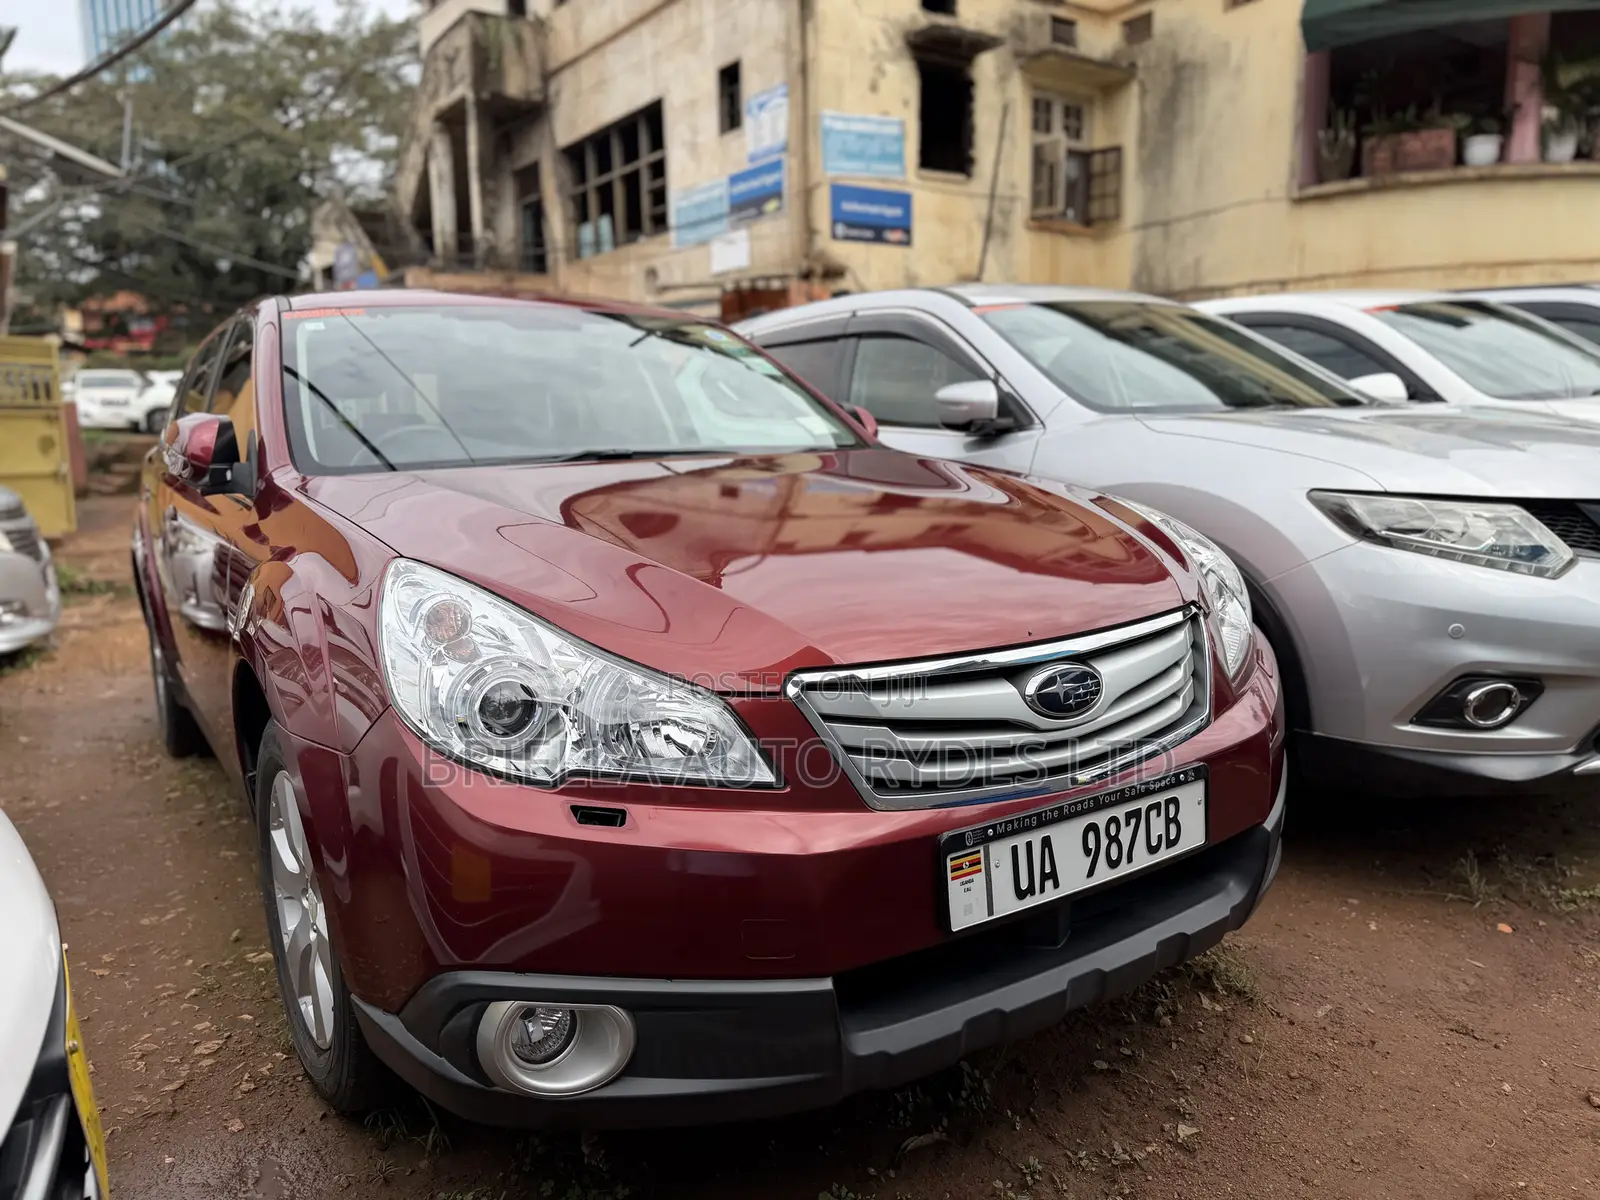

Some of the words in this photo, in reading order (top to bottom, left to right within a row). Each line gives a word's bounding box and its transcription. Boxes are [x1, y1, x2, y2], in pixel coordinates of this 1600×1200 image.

[996, 816, 1037, 835] Making
[1041, 809, 1059, 821] the
[1063, 800, 1095, 815] Roads
[1098, 792, 1121, 805] Your
[1124, 785, 1146, 797] Safe
[1149, 776, 1176, 791] Space
[1010, 835, 1060, 901] UA
[1082, 796, 1182, 878] 987CB
[959, 877, 975, 887] UGANDA
